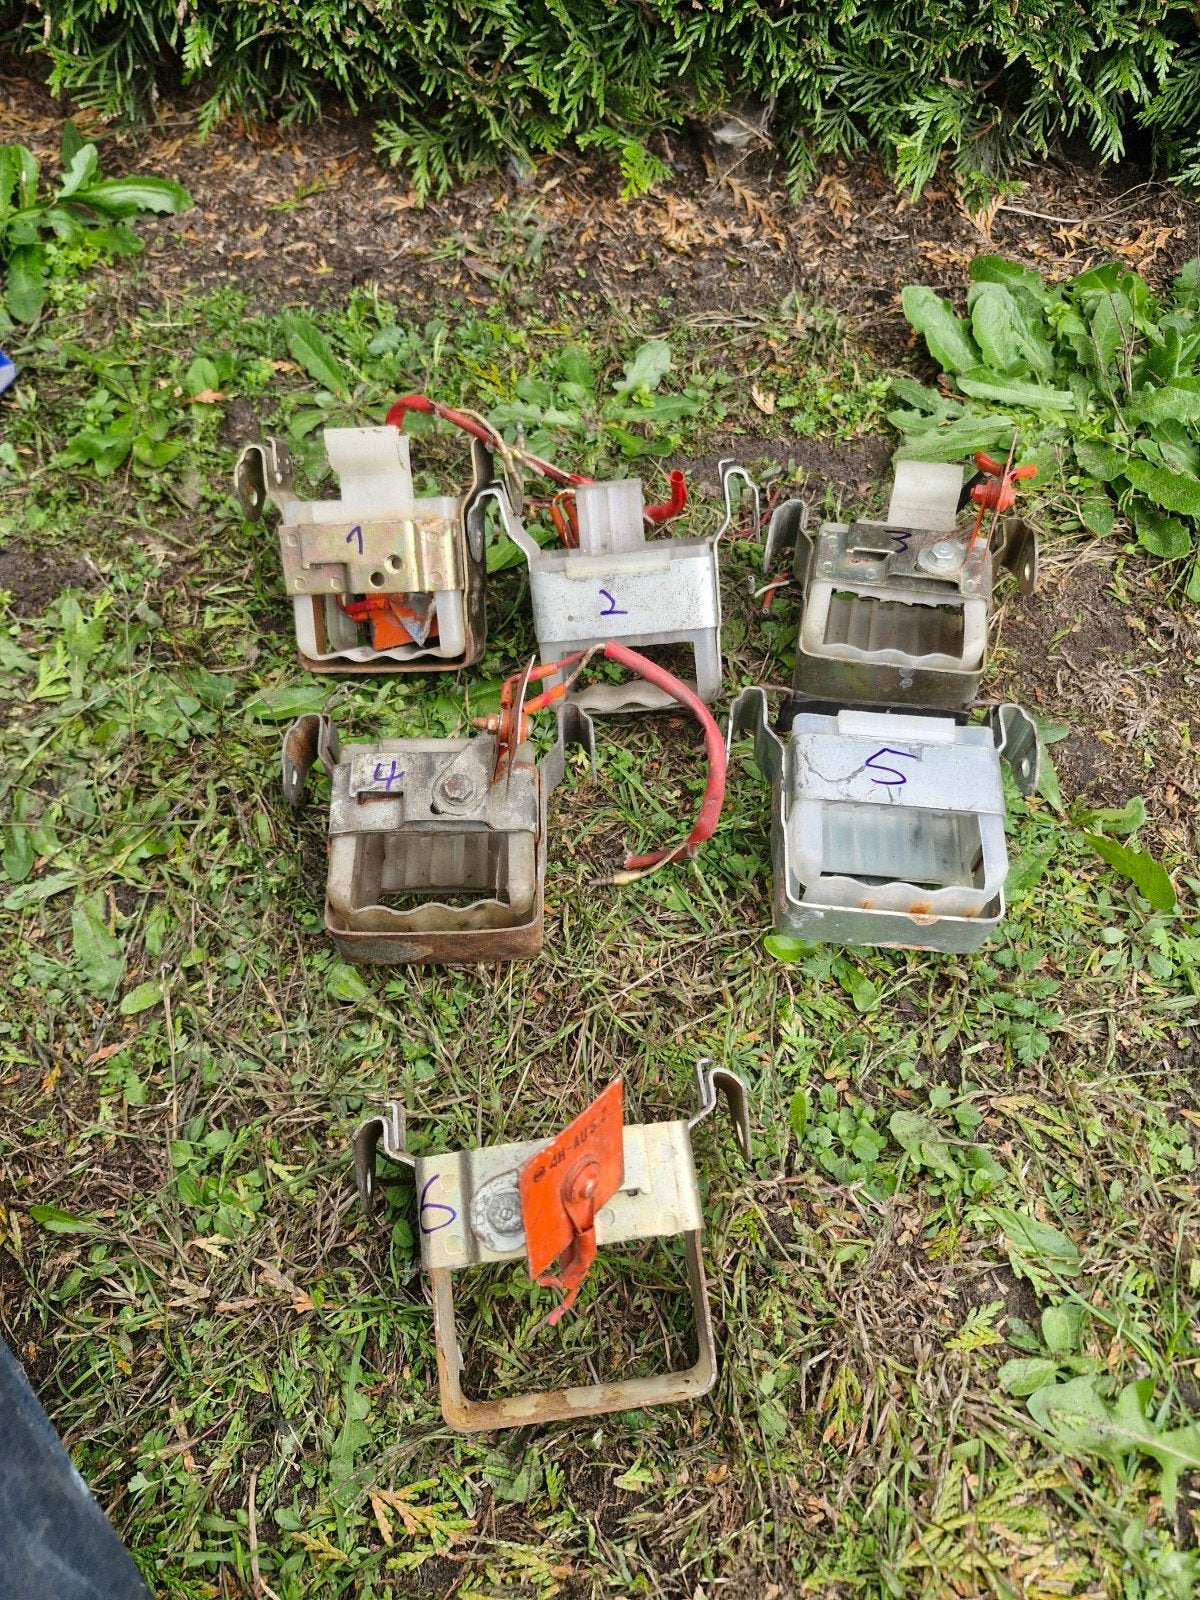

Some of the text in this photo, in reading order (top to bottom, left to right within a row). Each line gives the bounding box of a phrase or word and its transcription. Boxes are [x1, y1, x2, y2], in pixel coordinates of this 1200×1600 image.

[346, 525, 363, 555] 1
[883, 529, 912, 553] 3
[598, 589, 628, 615] 2
[373, 760, 406, 793] 4
[865, 747, 918, 785] 5
[420, 1173, 457, 1234] 6
